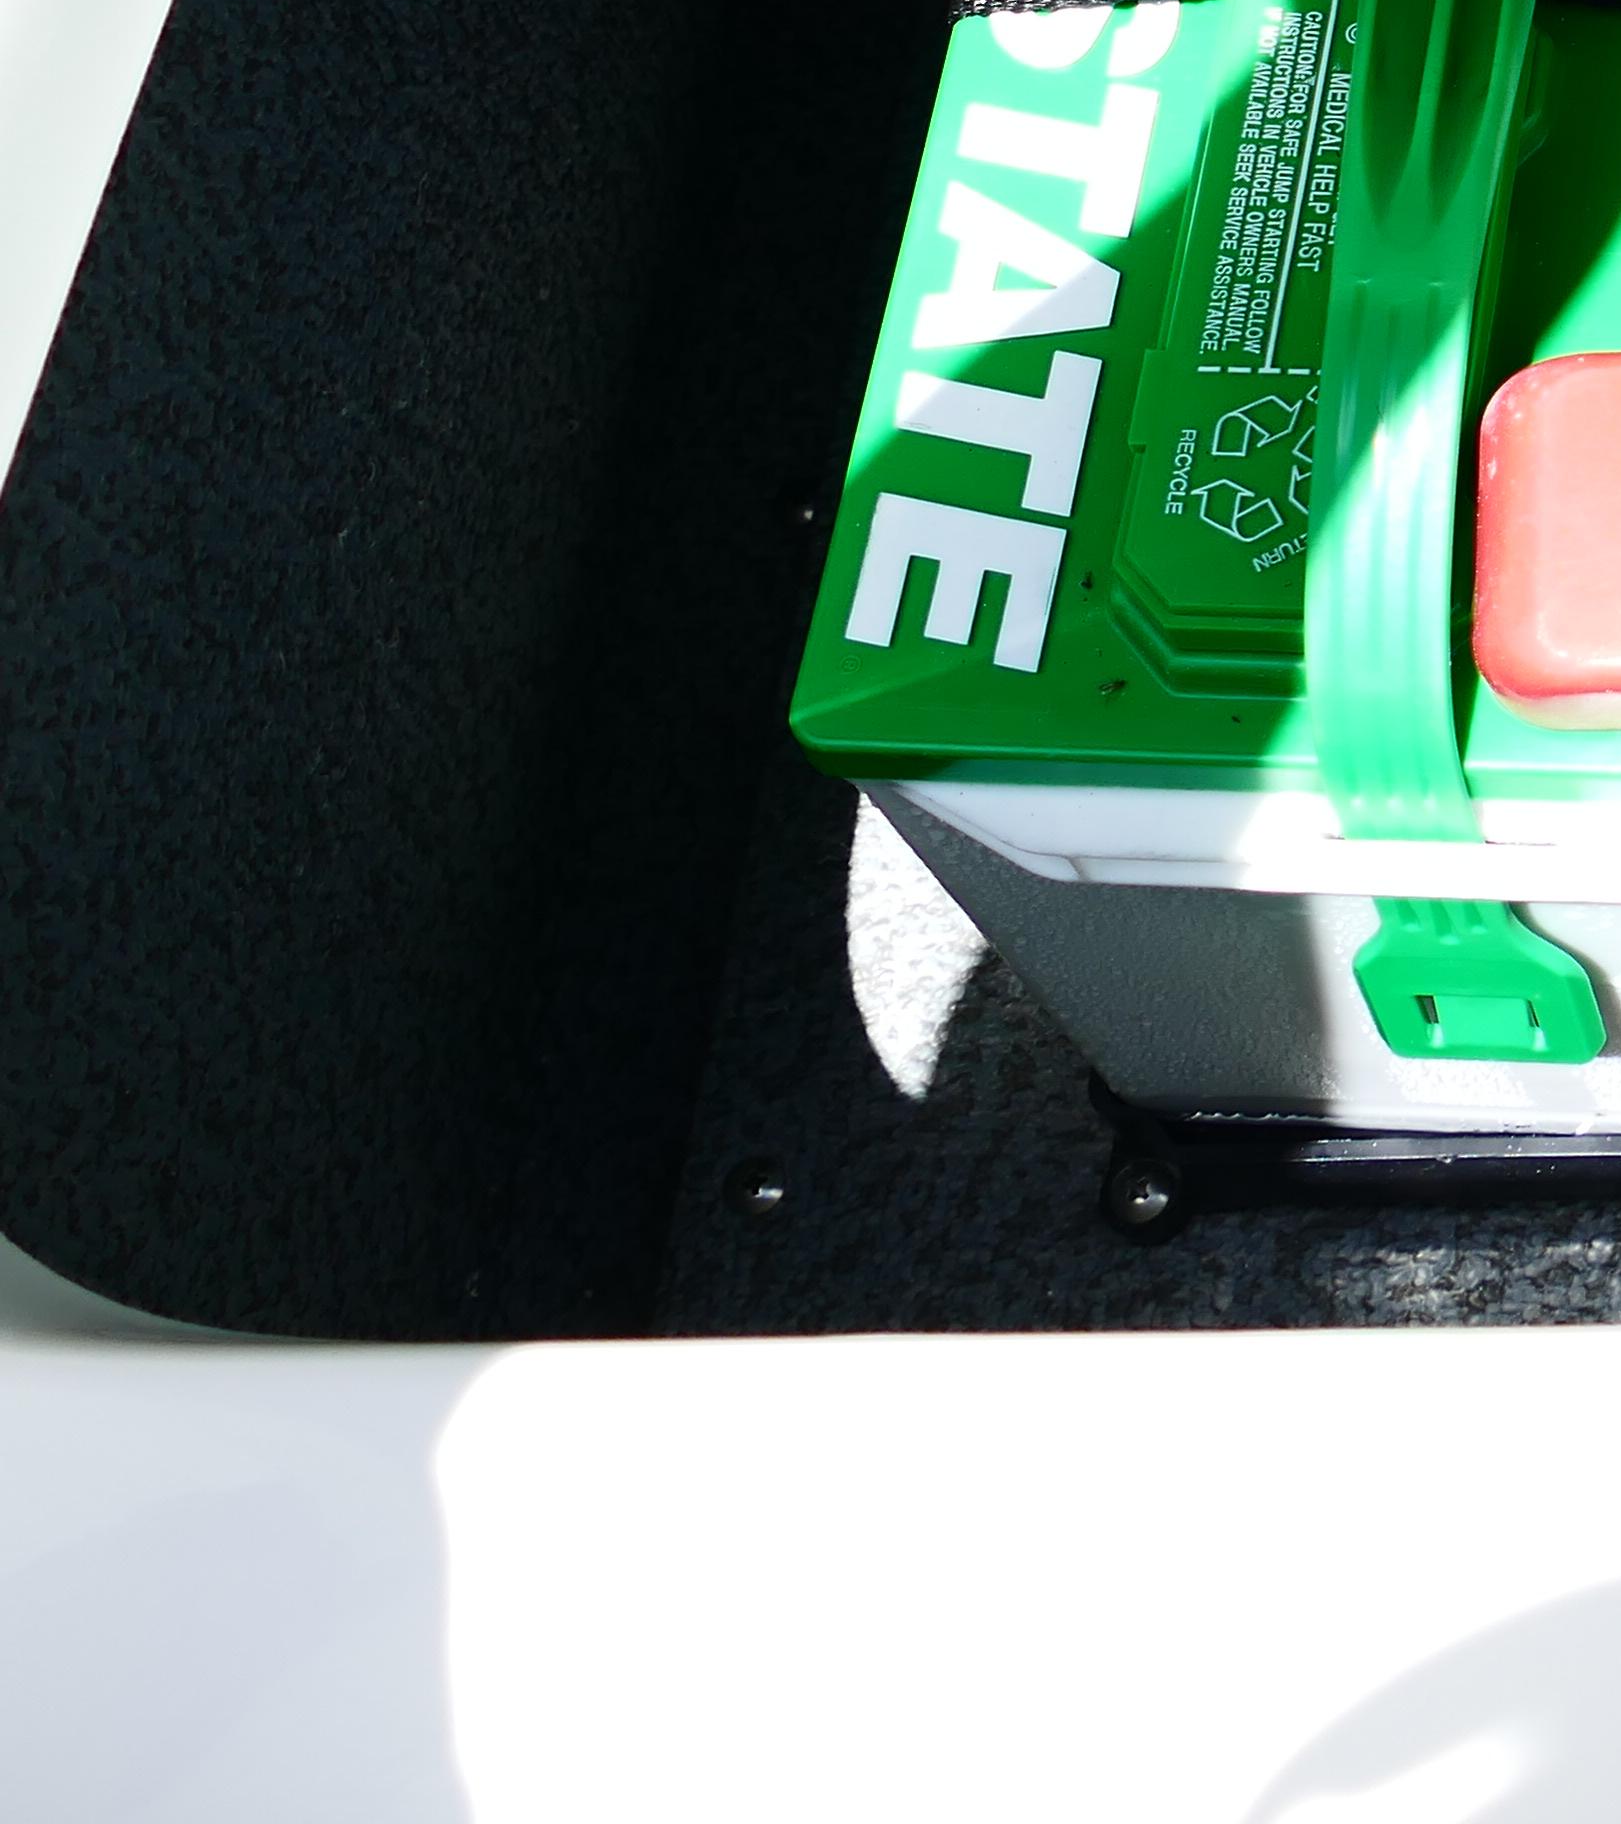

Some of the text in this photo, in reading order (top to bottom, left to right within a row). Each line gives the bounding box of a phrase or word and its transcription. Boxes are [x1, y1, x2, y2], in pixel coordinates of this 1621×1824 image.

[1258, 25, 1280, 58] NOT
[1265, 12, 1302, 119] INSTRUCTIONS
[1241, 61, 1272, 140] AVAILABLE
[1261, 124, 1282, 140] IN
[1317, 73, 1352, 157] MEDICAL
[1232, 143, 1257, 183] SEEK
[1243, 11, 1323, 354] CAUTION: FOR SAFE JUMP STARTING FOLLOW
[1249, 145, 1278, 207] VEHICLE
[1307, 164, 1338, 215] HELP
[1220, 187, 1249, 251] SERVICE
[1236, 211, 1265, 277] OWNERS
[1297, 222, 1327, 272] FAST
[1199, 255, 1235, 355] ASSISTANCE.
[1164, 429, 1197, 515] RECYCLE
